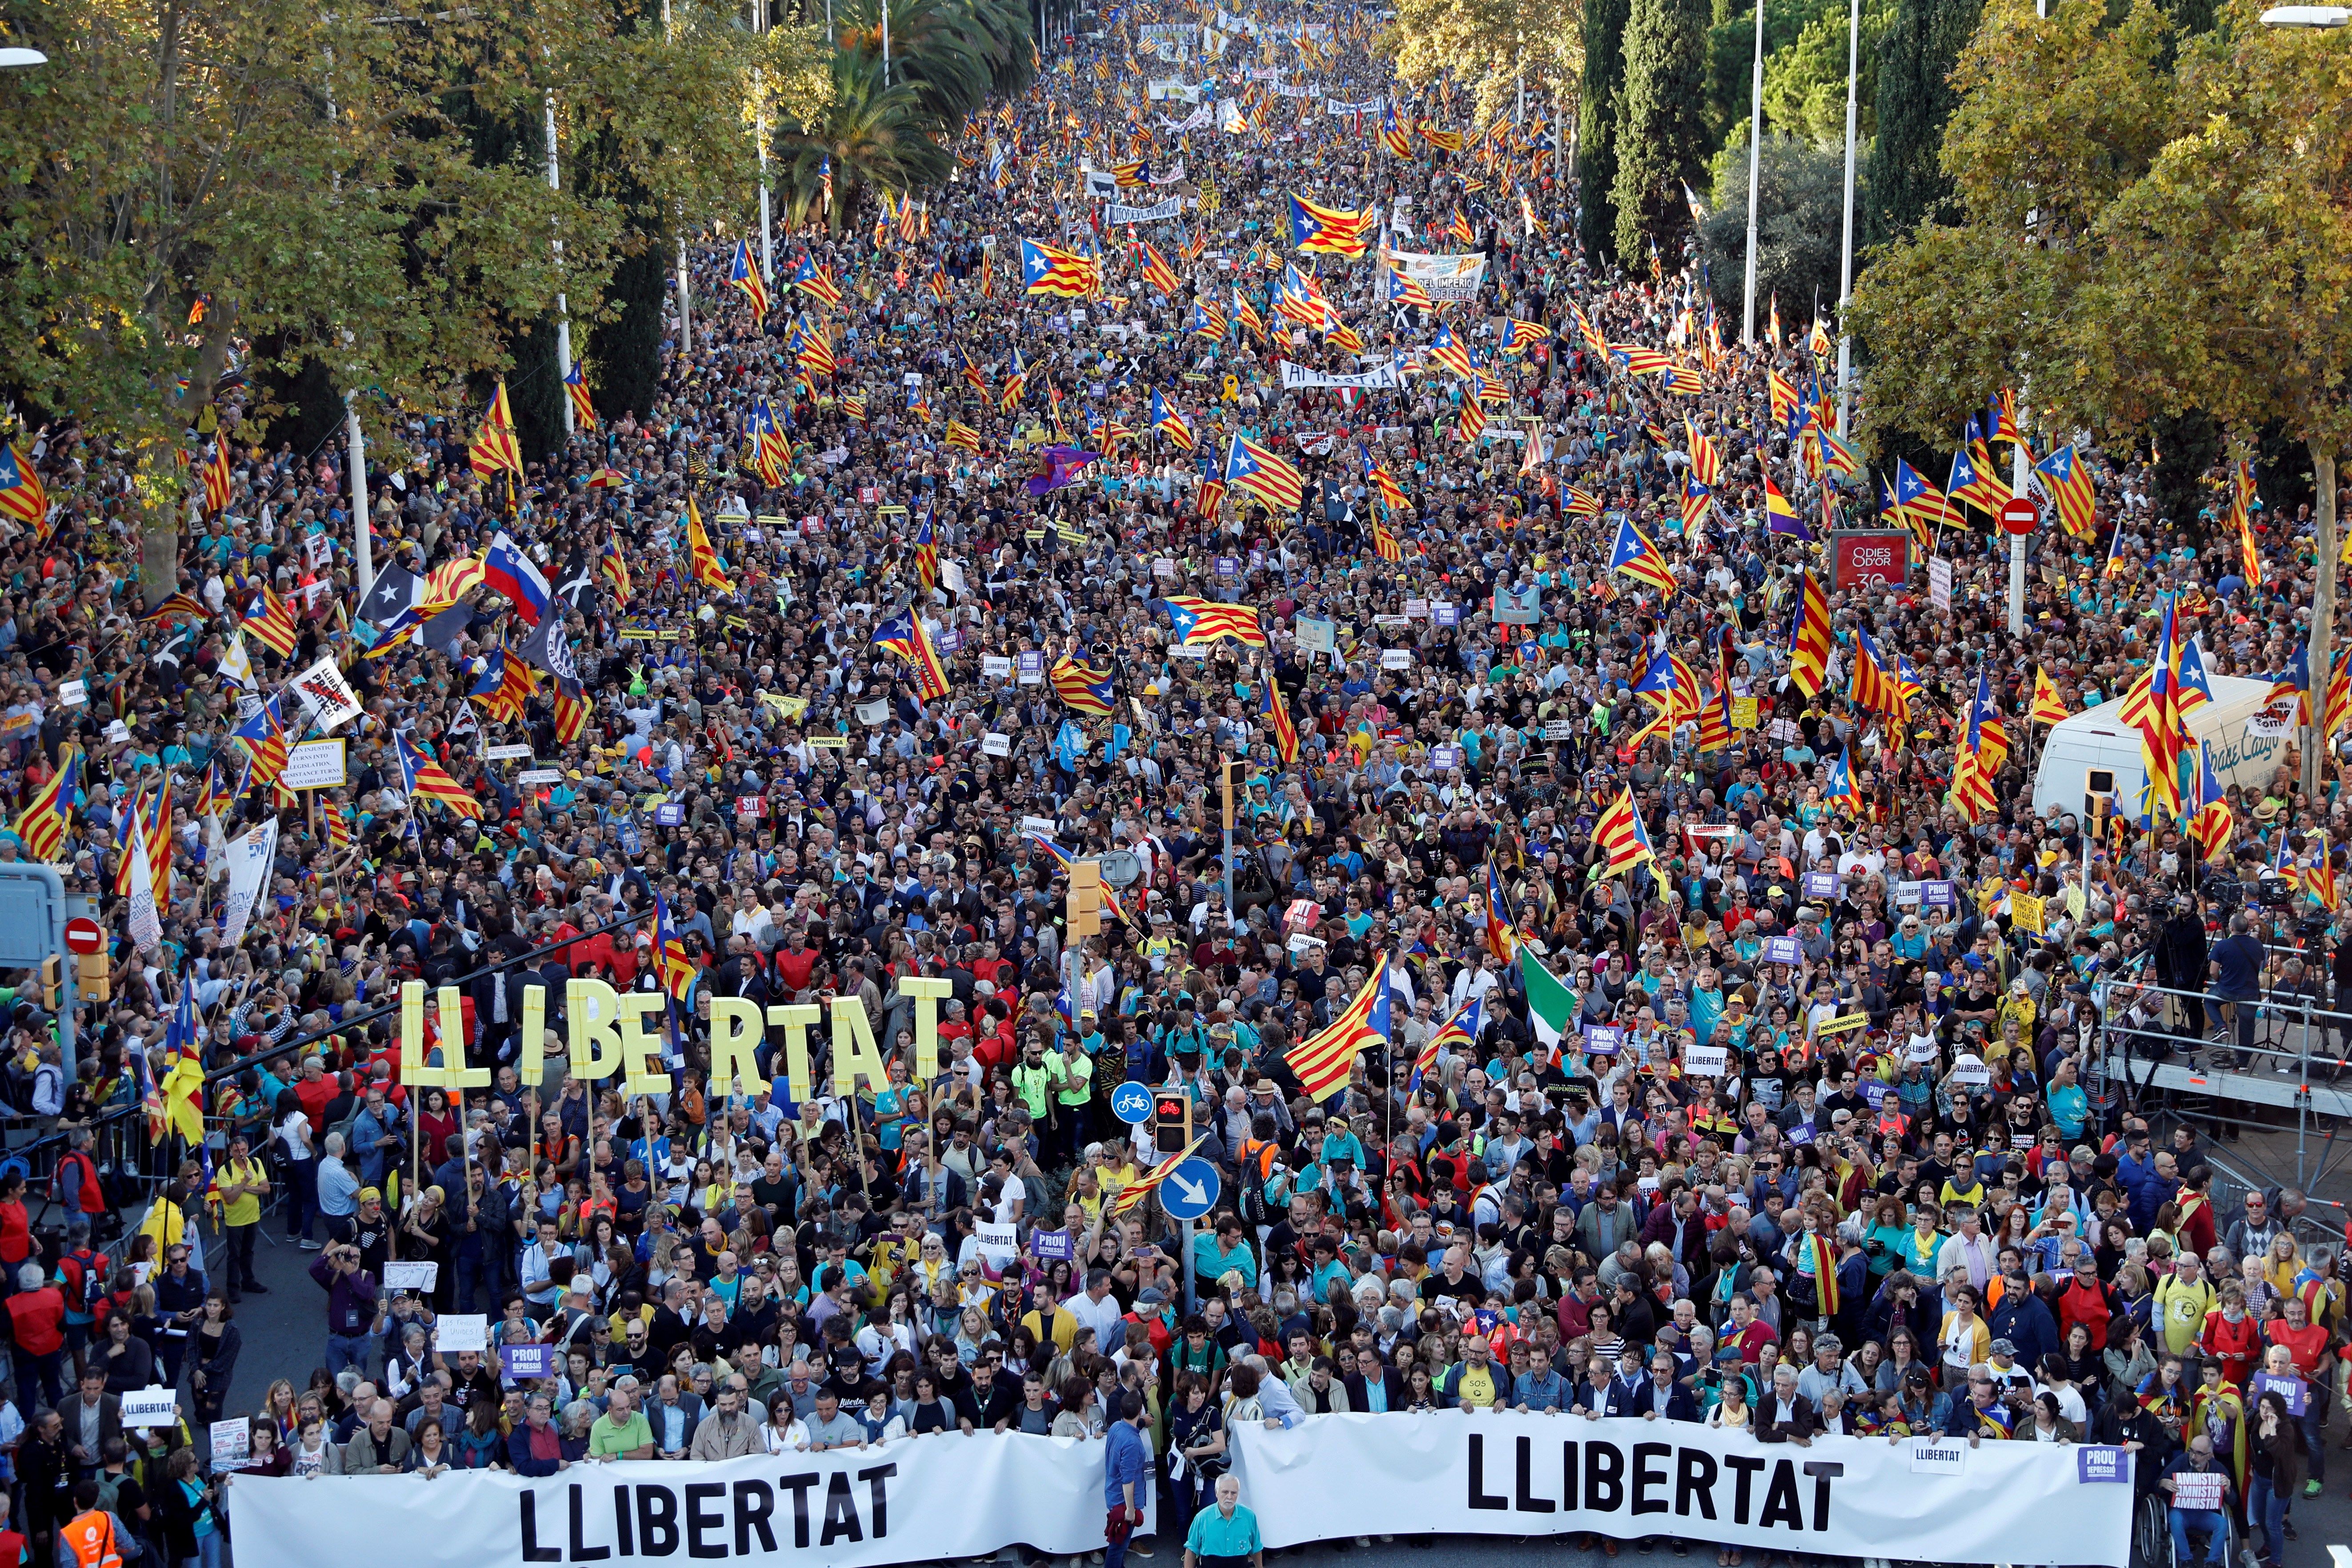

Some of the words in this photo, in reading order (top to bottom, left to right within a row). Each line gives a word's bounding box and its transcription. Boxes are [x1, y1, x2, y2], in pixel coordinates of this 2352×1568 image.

[1418, 278, 1435, 288] DEL
[1435, 289, 1448, 299] DE
[1448, 289, 1477, 301] ESTADO
[863, 488, 873, 497] SIT
[807, 516, 818, 526] SIT
[1253, 552, 1261, 560] PROU
[1852, 547, 1865, 567] 8
[1865, 548, 1891, 557] DIES
[1865, 557, 1891, 566] D'OR
[941, 635, 956, 645] PROU
[321, 668, 350, 706] LLIBERTAT
[1733, 688, 1746, 697] PROU
[63, 688, 83, 699] LLIBERTAT
[984, 740, 1007, 748] LLIBERTAT
[2240, 725, 2279, 761] Cargo
[1435, 751, 1452, 760] PROU
[304, 775, 343, 784] OBLIGATION
[743, 798, 759, 810] SIT
[661, 806, 678, 815] PROU
[1025, 824, 1048, 832] LLIBERT
[1812, 876, 1832, 885] PROU
[1899, 888, 1920, 896] LLIBERT
[1928, 884, 1948, 894] PROU
[1293, 900, 1312, 916] SIT
[2015, 900, 2027, 909] FINS
[1295, 915, 1307, 925] TALK
[1773, 939, 1795, 951] PROU
[1820, 1017, 1864, 1031] INDEPENDÈNCIA
[401, 976, 952, 1103] LLIBERTAT
[1592, 1028, 1615, 1041] PROU
[1688, 1056, 1723, 1066] LLIBERTAT
[1254, 1193, 1262, 1220] CASTELLERS
[1257, 1190, 1265, 1220] VILAFRANCA
[978, 1233, 1013, 1246] LLIBERTAT
[1039, 1235, 1065, 1247] PROU
[2174, 1300, 2183, 1320] FREE
[512, 1349, 541, 1361] PROU
[513, 1361, 542, 1370] REPRESSIÓ
[2265, 1379, 2296, 1397] PROU
[126, 1403, 171, 1414] LLIBERTAT
[1916, 1449, 1960, 1462] LLIBERTAT
[2087, 1451, 2116, 1464] PROU
[2087, 1465, 2116, 1473] REPRESSIÓ
[1468, 1434, 1844, 1531] LLIBERTAT
[2176, 1473, 2221, 1485] AMNISTIA
[2176, 1485, 2220, 1497] AMNISTIA
[2174, 1497, 2219, 1509] AMNISTIA
[520, 1463, 897, 1563] LLIBERTAT
